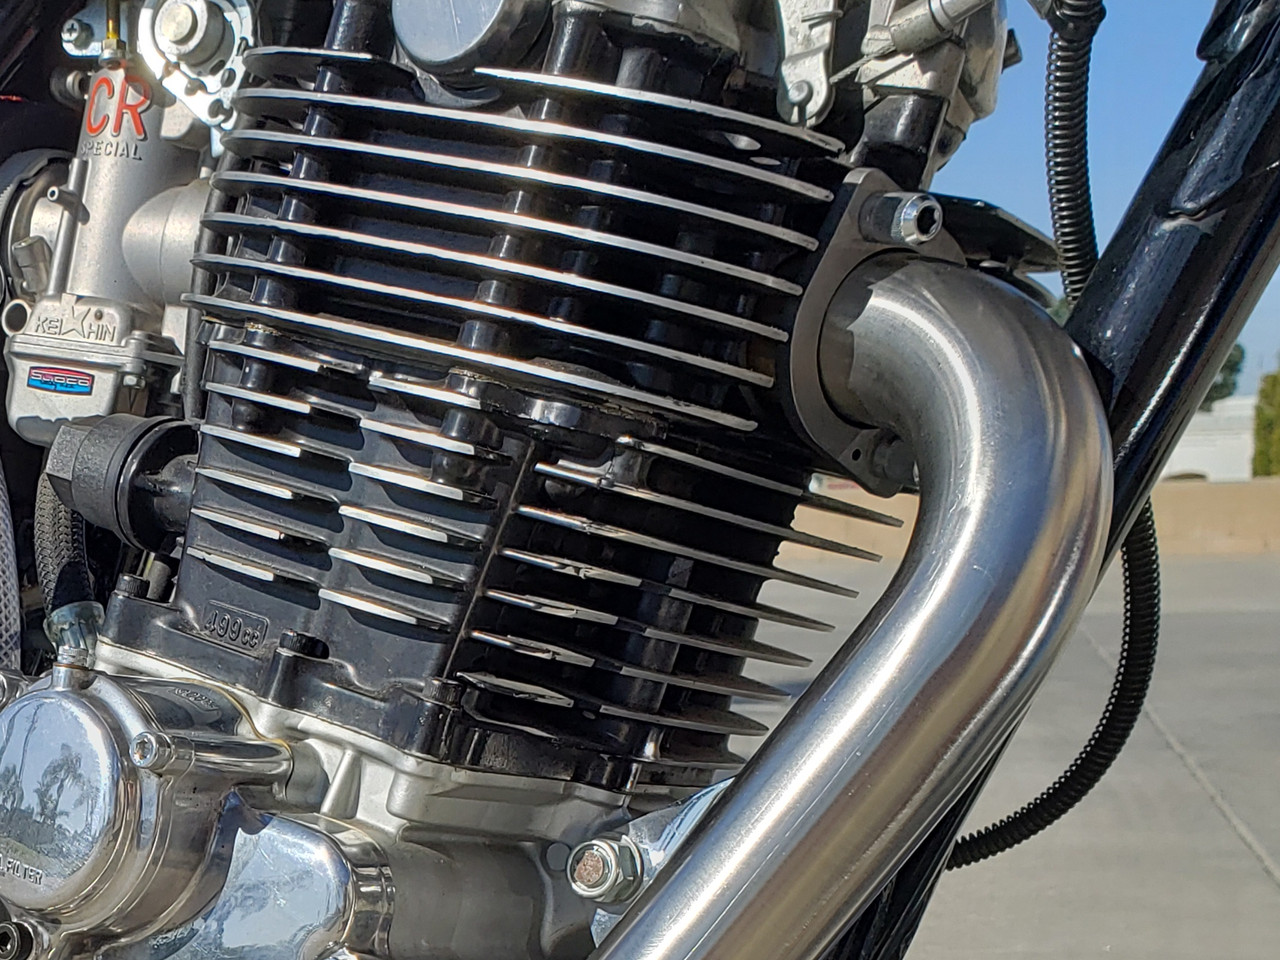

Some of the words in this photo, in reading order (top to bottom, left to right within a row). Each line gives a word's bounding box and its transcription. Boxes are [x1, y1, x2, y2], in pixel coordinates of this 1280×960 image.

[86, 76, 152, 139] CR
[80, 140, 143, 161] SPECIAL
[204, 608, 261, 649] 499cc
[6, 857, 44, 885] FILTER
